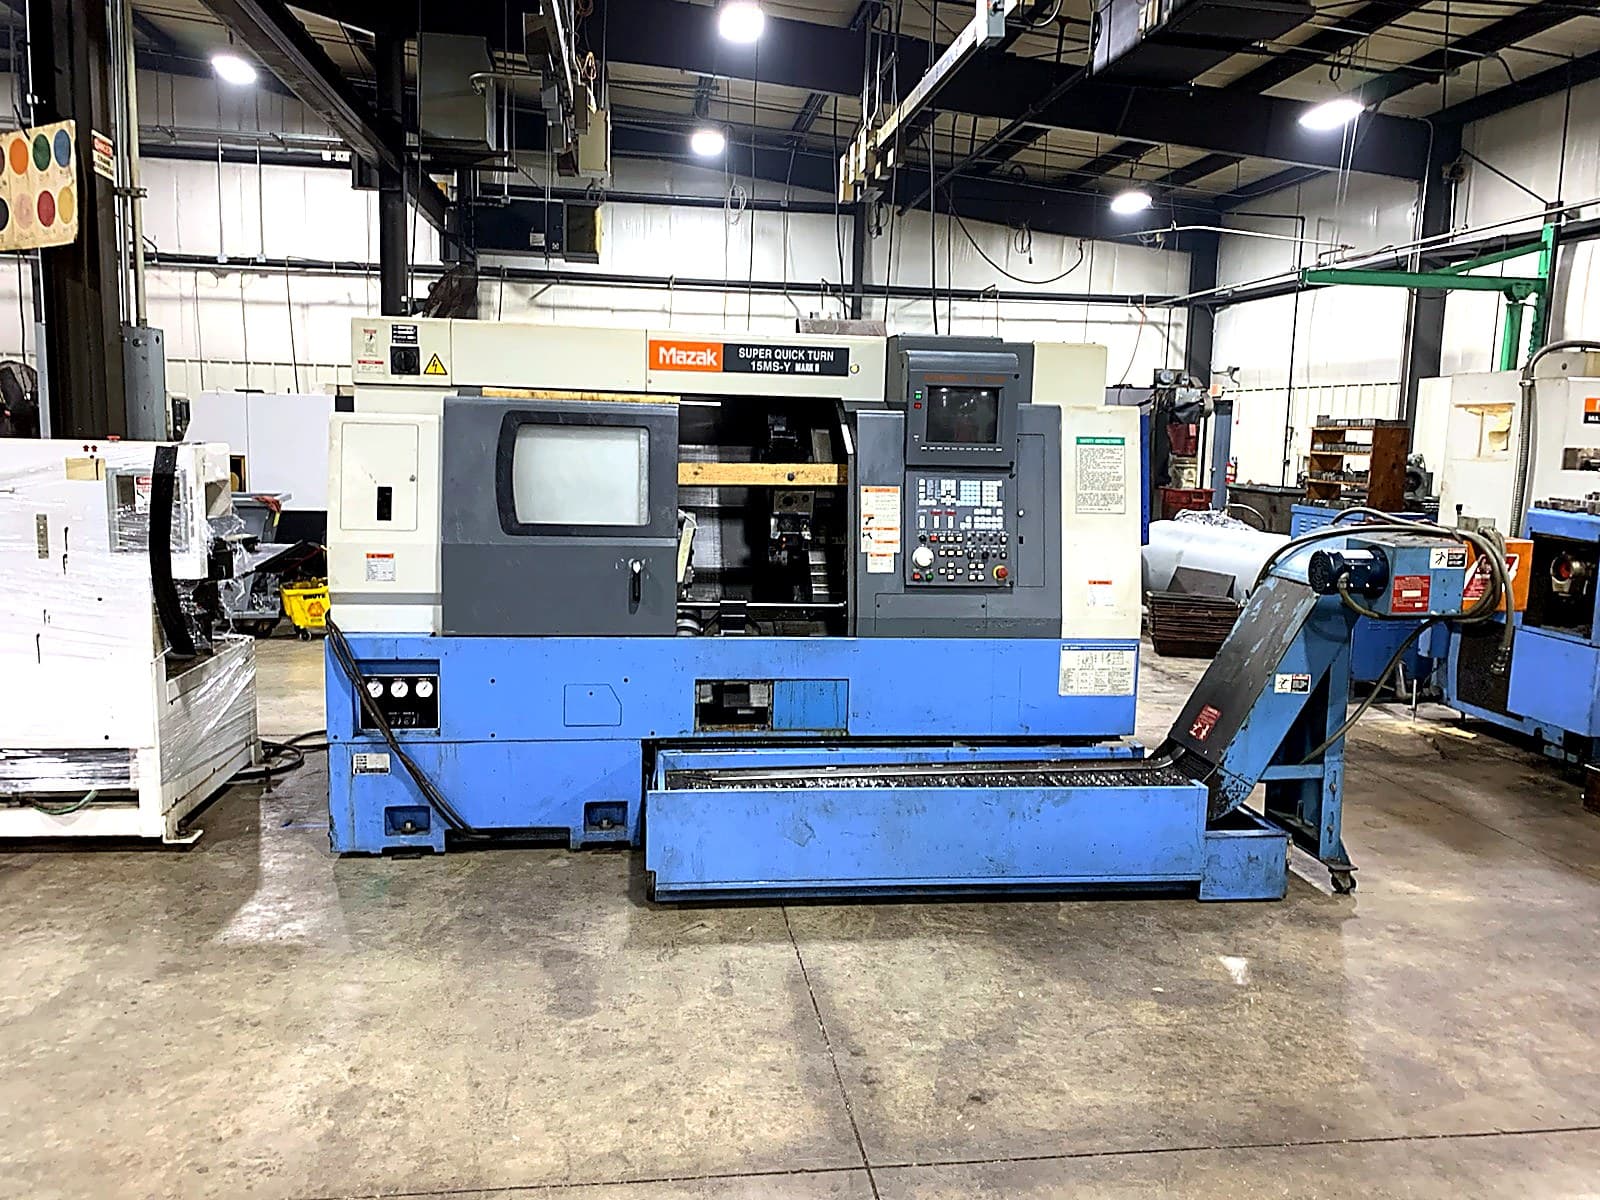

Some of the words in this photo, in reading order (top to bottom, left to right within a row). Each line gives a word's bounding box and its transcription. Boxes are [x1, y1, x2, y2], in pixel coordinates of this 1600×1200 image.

[658, 346, 718, 367] Mazak
[738, 347, 772, 359] SUPER
[774, 348, 806, 361] QUICK
[807, 350, 834, 362] TURN
[750, 361, 791, 372] 15MS-Y
